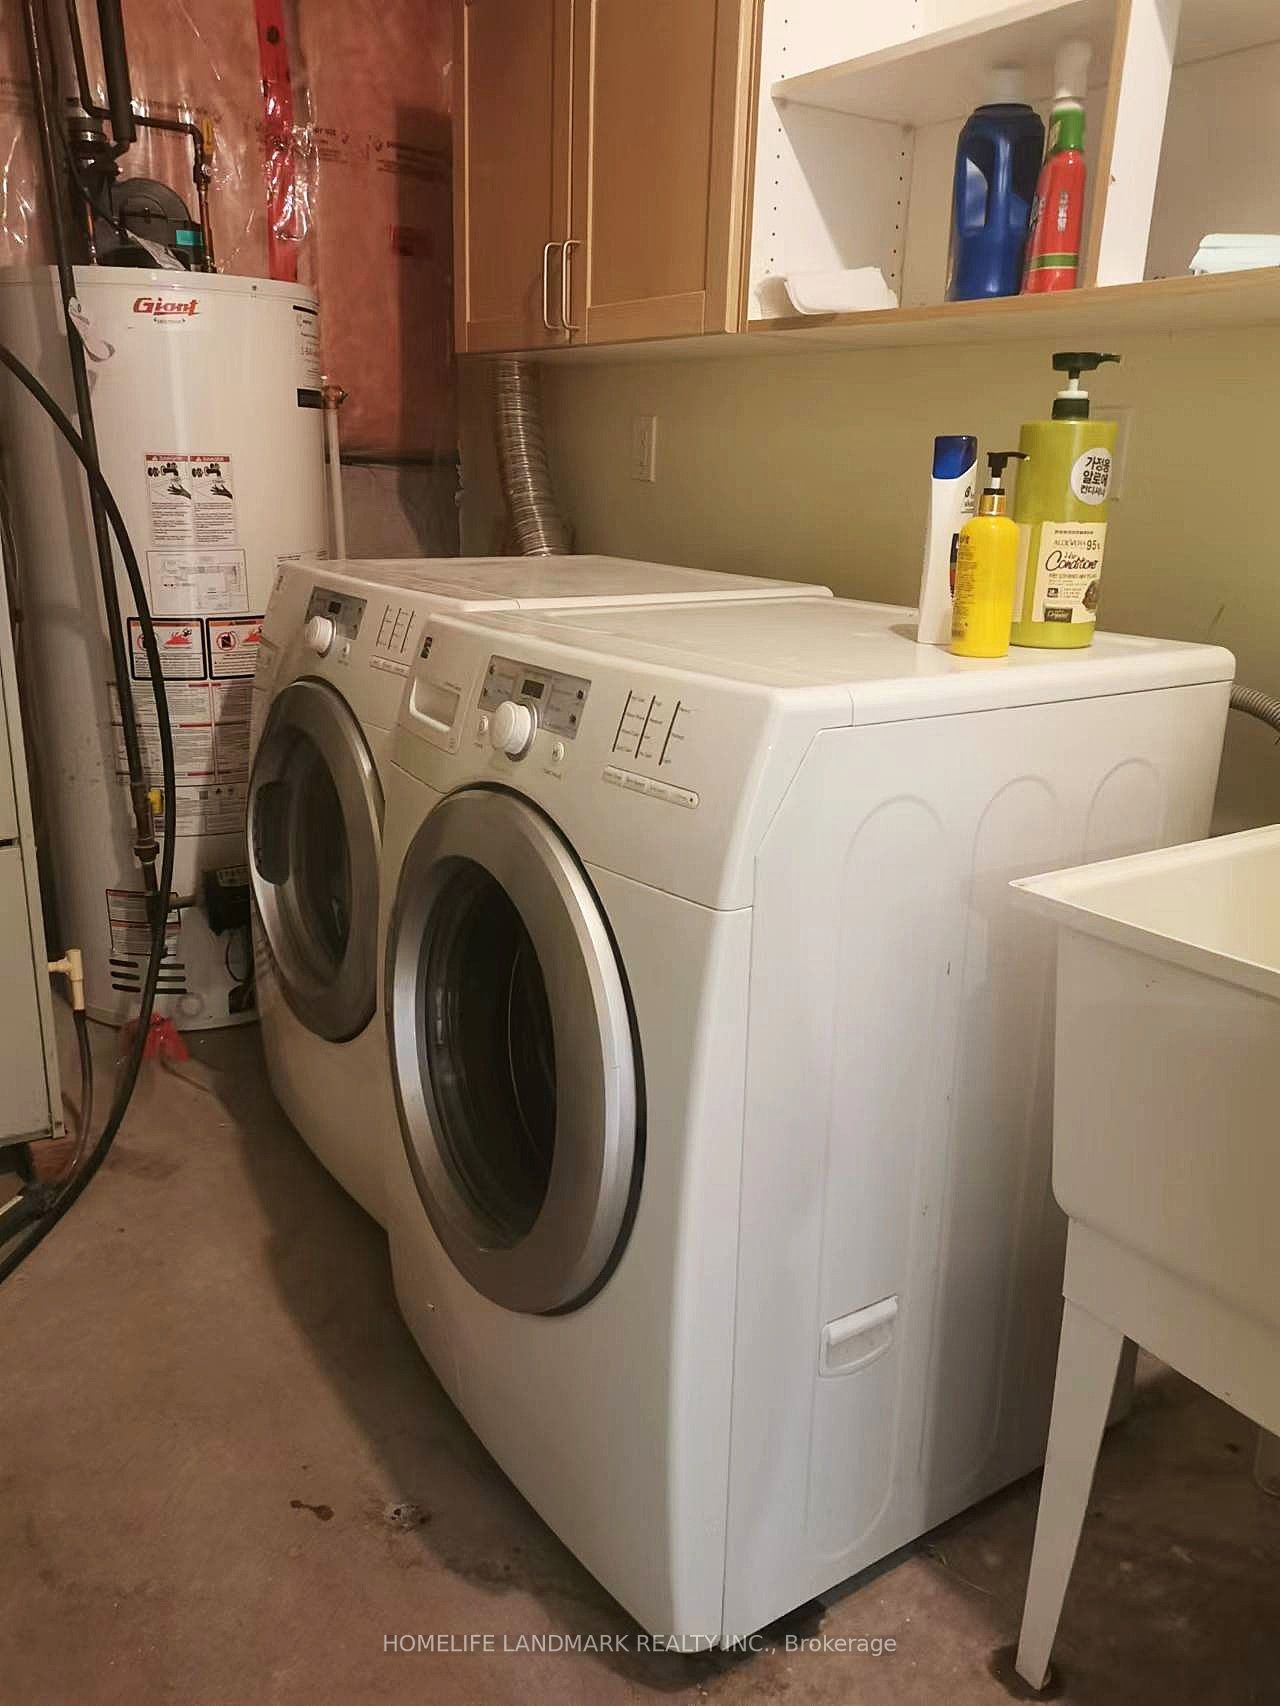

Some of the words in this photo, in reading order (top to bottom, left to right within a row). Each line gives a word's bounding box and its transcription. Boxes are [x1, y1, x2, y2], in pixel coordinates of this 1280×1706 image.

[133, 297, 200, 316] Giant
[1085, 456, 1110, 473] 가정용
[1083, 470, 1108, 487] 알로에
